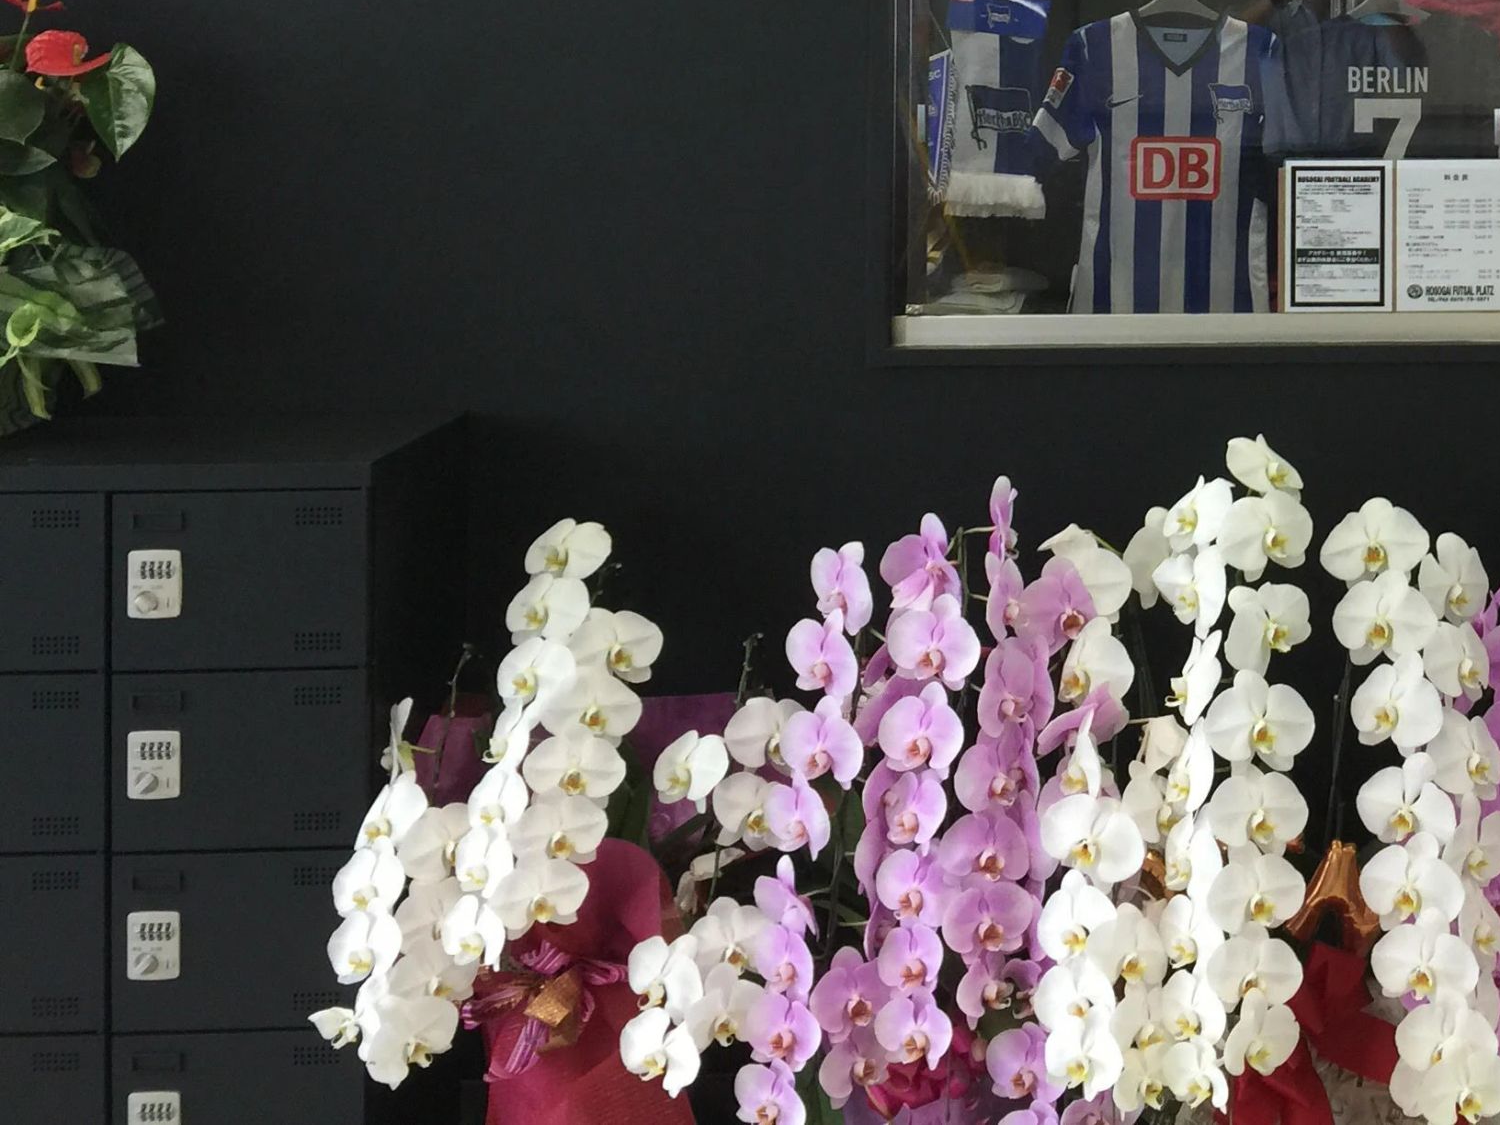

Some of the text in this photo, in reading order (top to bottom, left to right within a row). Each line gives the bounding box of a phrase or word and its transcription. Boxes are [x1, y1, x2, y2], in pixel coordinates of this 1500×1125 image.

[1347, 66, 1429, 93] BERLIN
[1353, 98, 1422, 160] 7
[1142, 147, 1210, 190] DB
